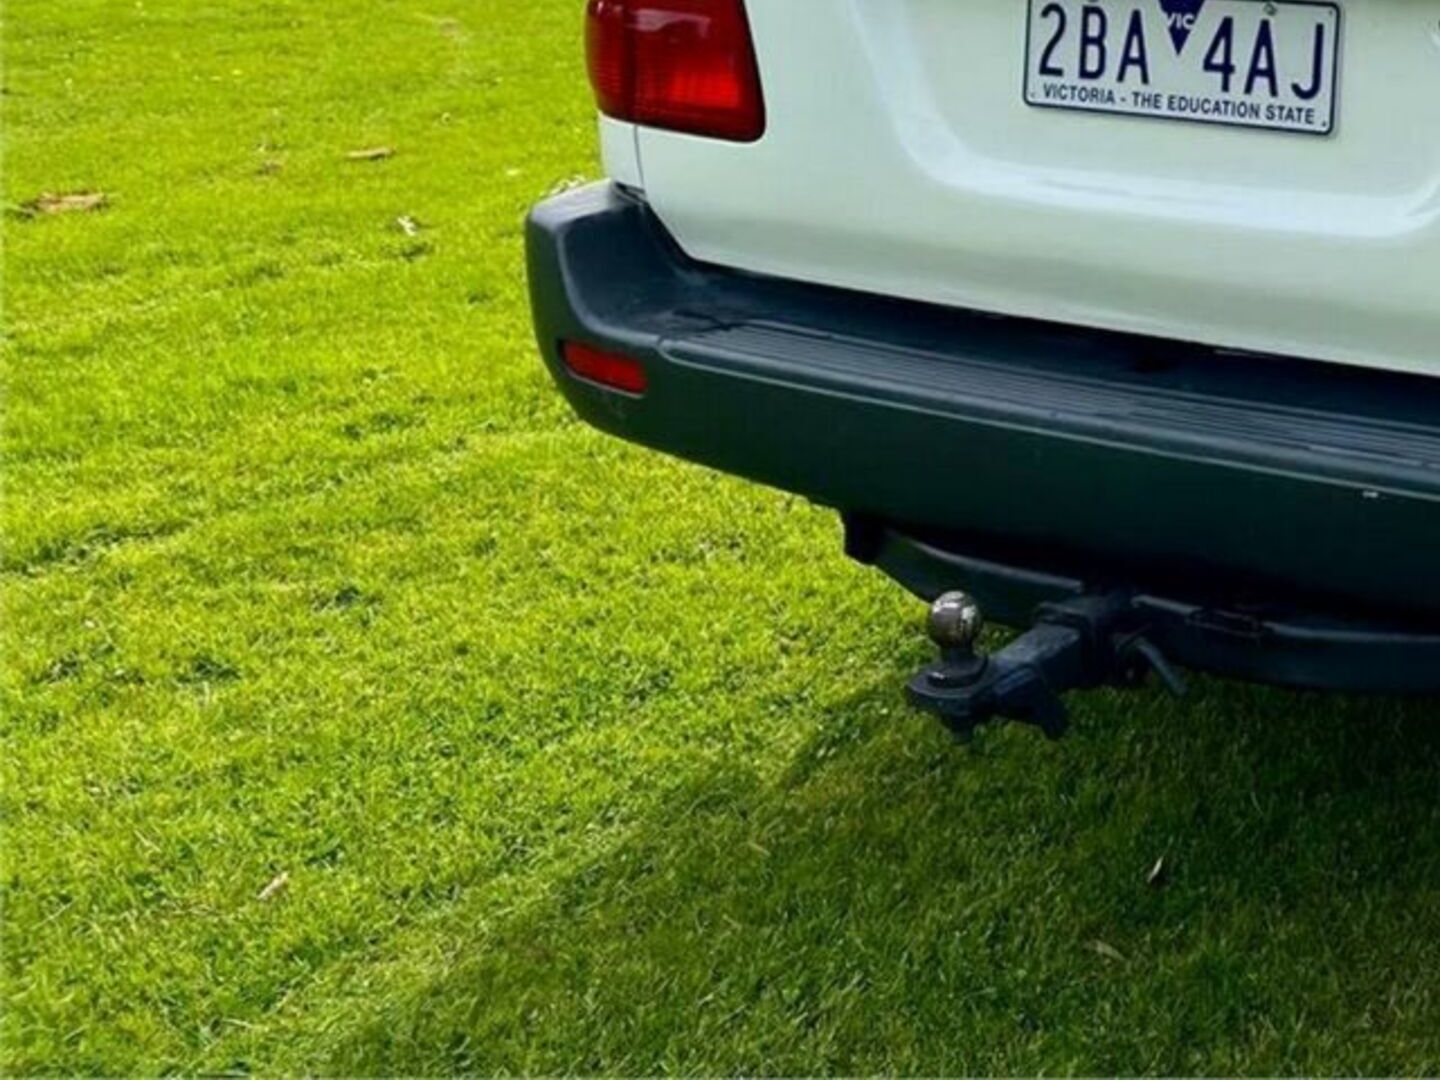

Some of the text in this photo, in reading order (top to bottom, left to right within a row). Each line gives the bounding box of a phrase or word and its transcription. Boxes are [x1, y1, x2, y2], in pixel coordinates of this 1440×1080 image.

[1043, 83, 1116, 105] VICTORIA
[1132, 91, 1163, 110] THE
[1167, 94, 1261, 119] EDUCATION
[1265, 103, 1316, 125] STATE
